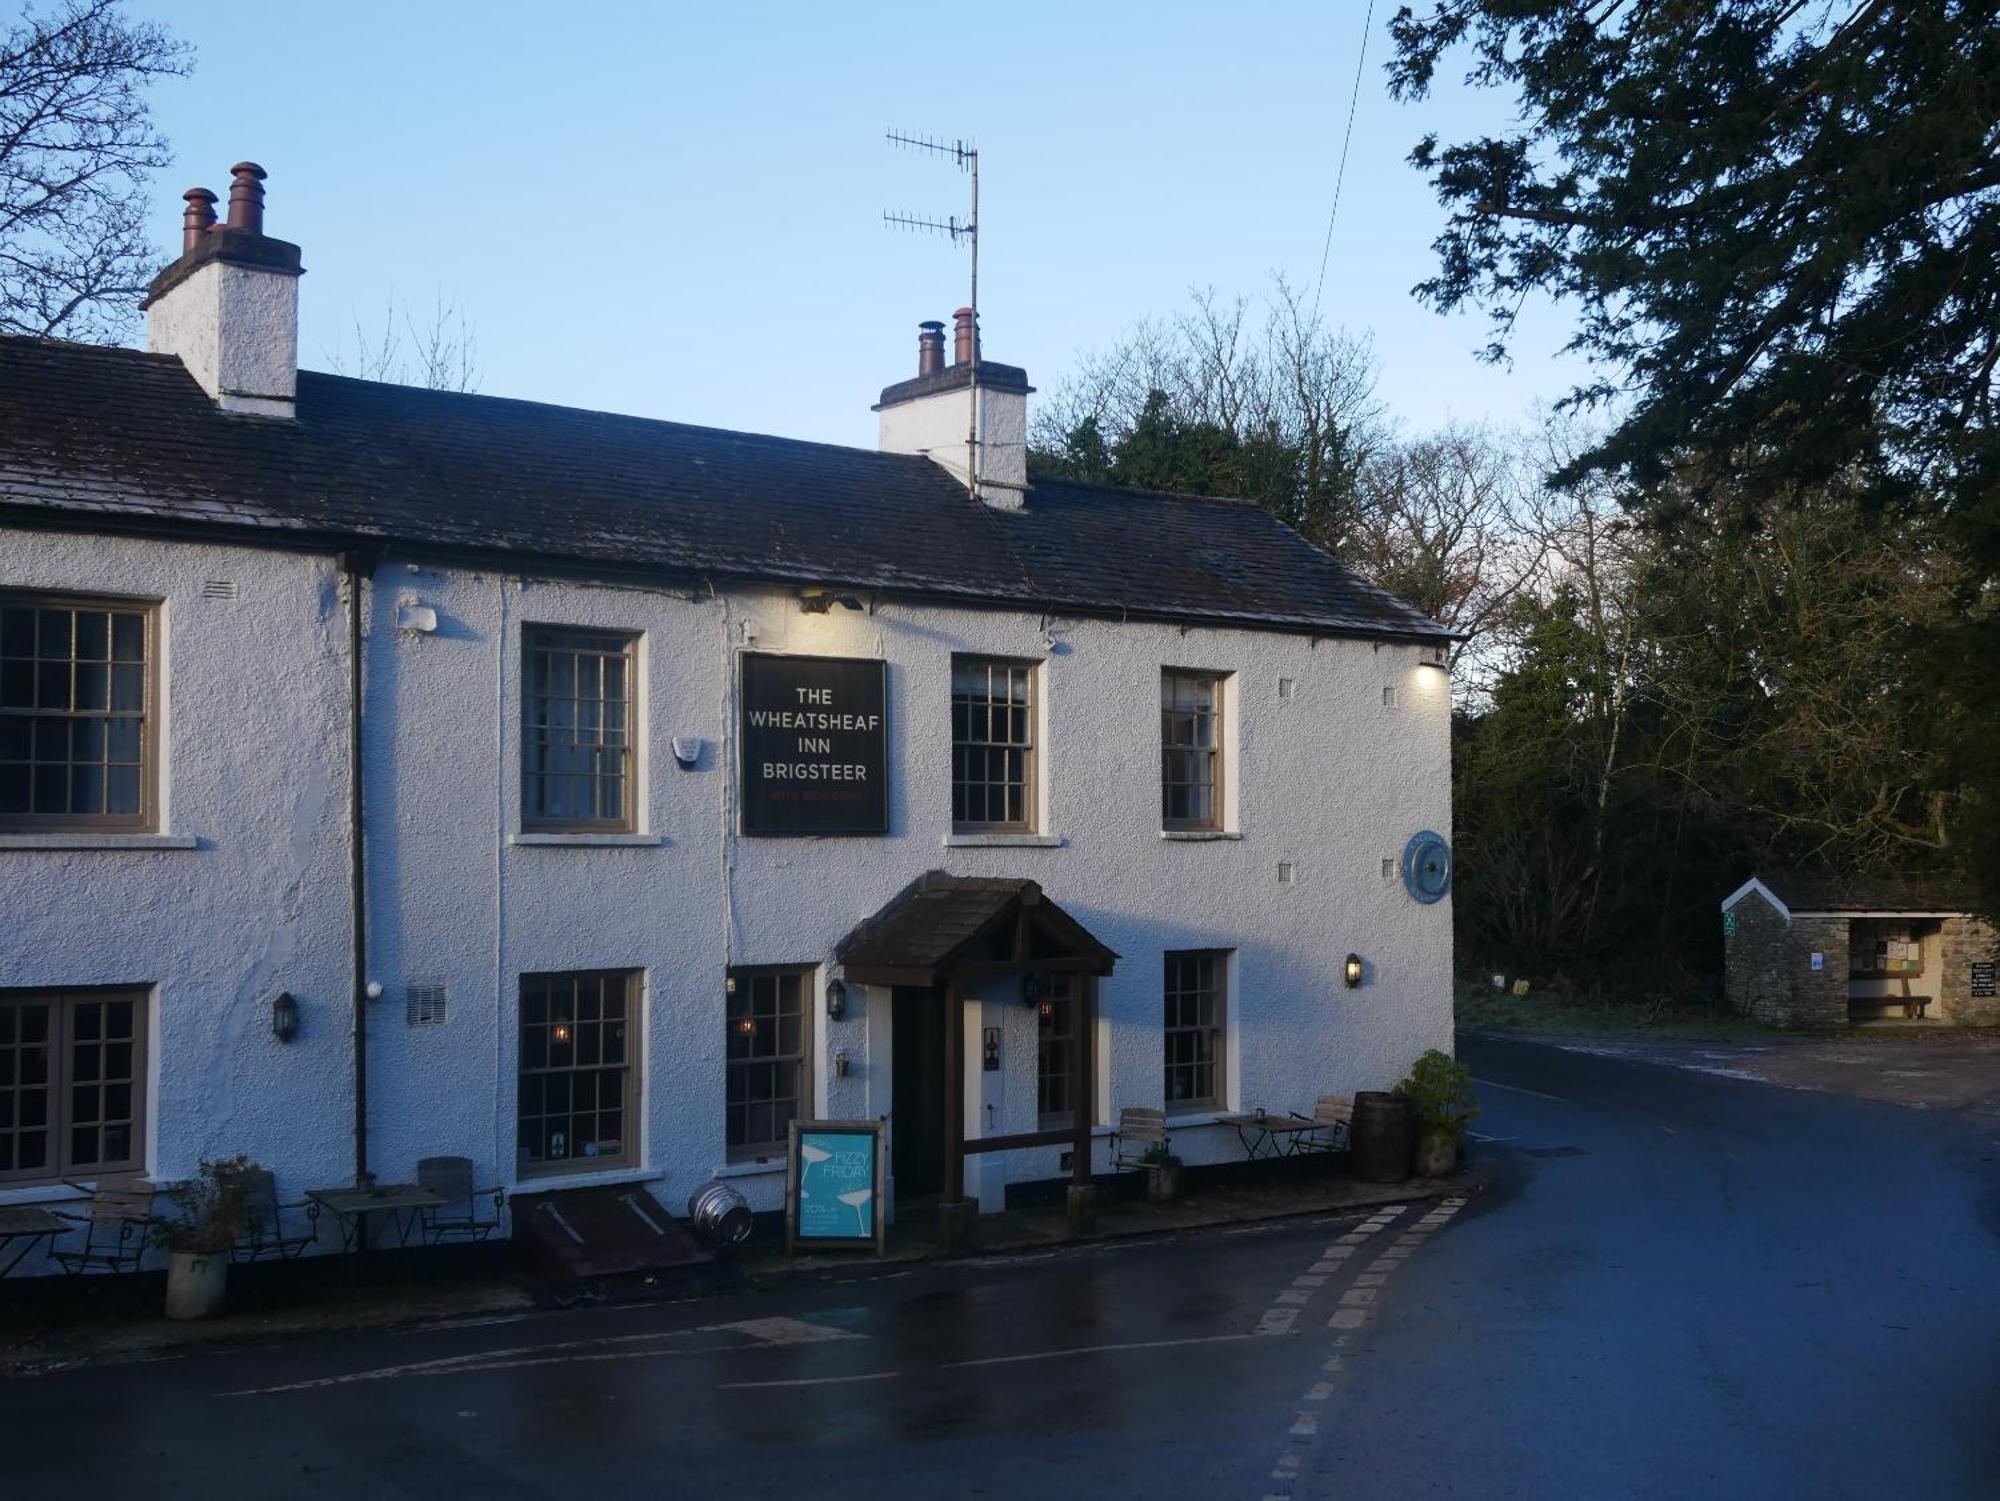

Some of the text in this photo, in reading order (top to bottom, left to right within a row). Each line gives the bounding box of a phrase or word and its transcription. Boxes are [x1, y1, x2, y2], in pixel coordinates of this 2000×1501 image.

[796, 688, 832, 705] THE
[749, 711, 879, 731] WHEATSHEAF
[798, 738, 830, 754] INN
[763, 763, 867, 781] BRIGSTEER
[835, 1151, 869, 1165] FIZZY
[823, 1165, 868, 1179] FRIDAY
